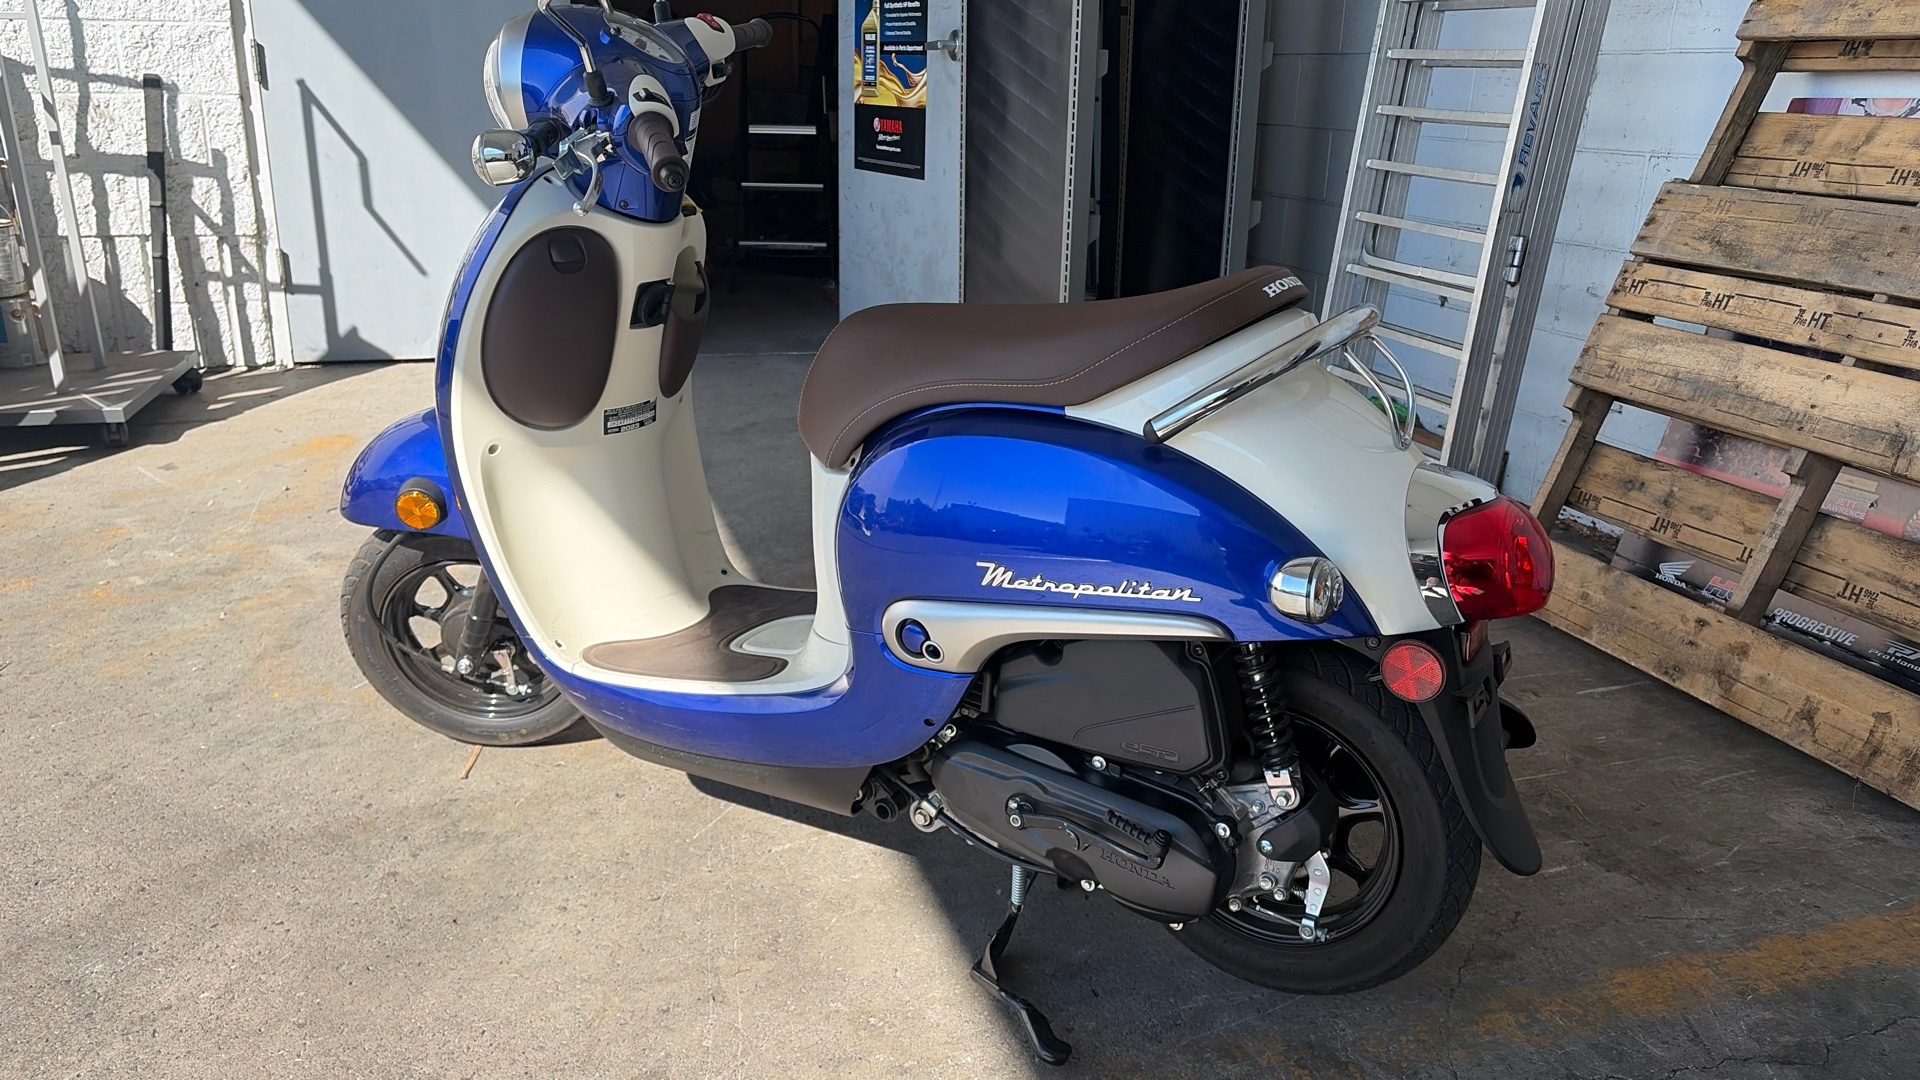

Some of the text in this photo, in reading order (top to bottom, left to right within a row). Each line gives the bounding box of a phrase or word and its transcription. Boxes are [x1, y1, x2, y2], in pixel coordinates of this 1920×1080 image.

[880, 119, 902, 133] YAMAHA
[1789, 162, 1812, 177] HT
[1886, 169, 1911, 186] HT
[1628, 279, 1648, 294] HT
[1711, 293, 1735, 310] HT
[1807, 311, 1833, 330] HT
[1575, 490, 1593, 507] HT
[1822, 503, 1867, 520] LAWRENCE
[1650, 516, 1671, 535] HT
[976, 561, 1202, 602] Metropolitan
[1655, 573, 1687, 588] HONDA
[1837, 582, 1864, 604] HT
[1769, 607, 1860, 646] PROGRESSIVE
[1868, 648, 1890, 660] Pro
[1100, 848, 1176, 890] HONDA
